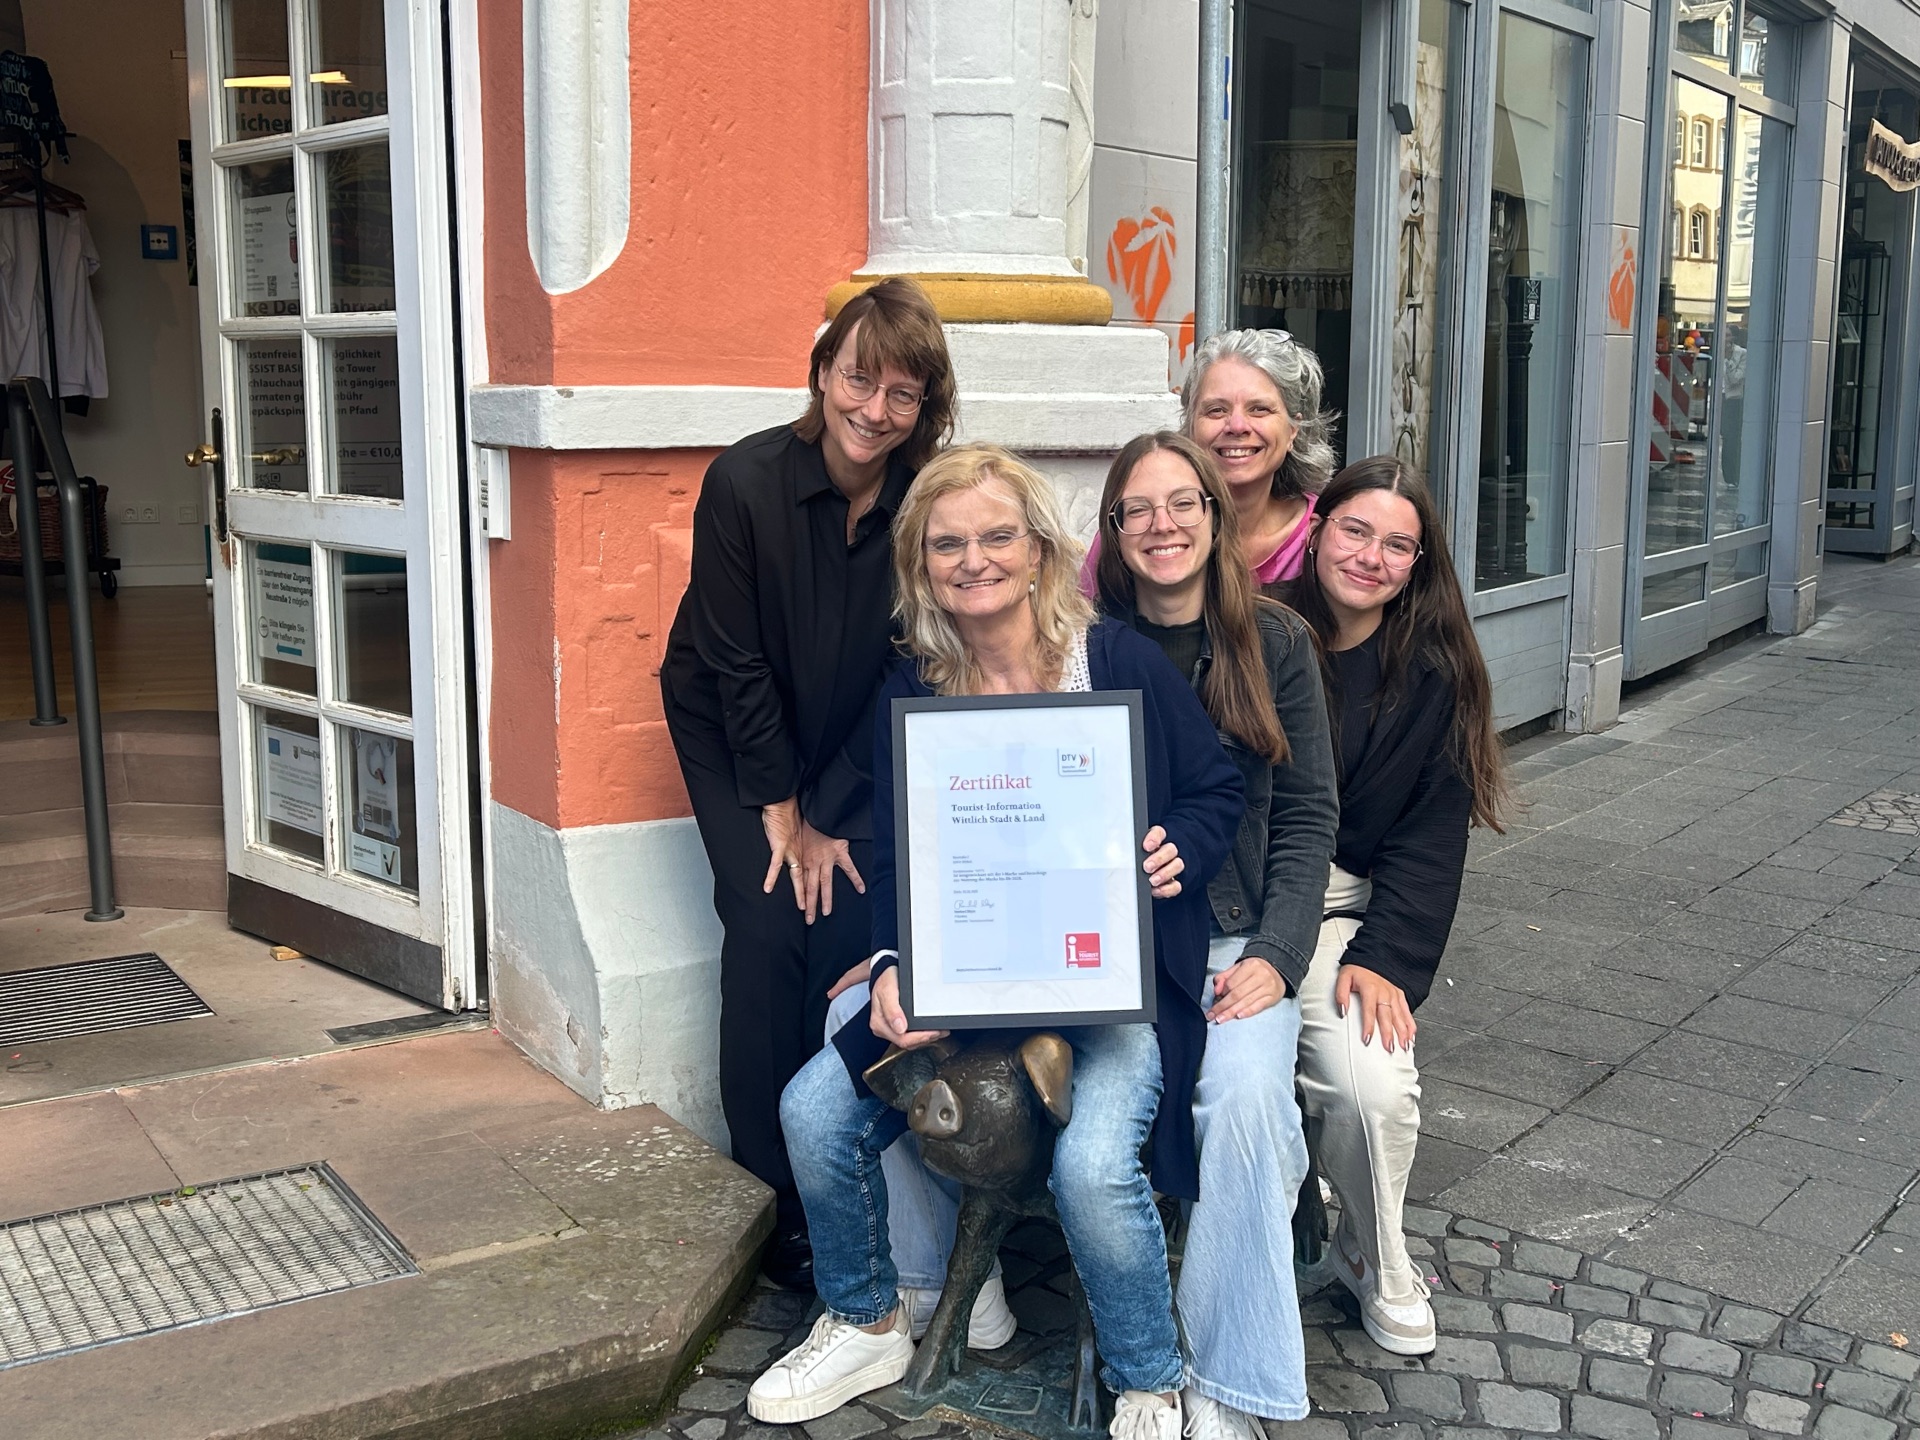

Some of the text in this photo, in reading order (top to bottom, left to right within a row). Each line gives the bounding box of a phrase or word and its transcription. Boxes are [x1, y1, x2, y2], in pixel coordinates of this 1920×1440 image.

[247, 349, 297, 359] ostenfreie
[249, 364, 276, 373] SSIST
[278, 364, 302, 373] BASI
[347, 363, 376, 373] Tower
[248, 378, 303, 388] chlauchaut
[350, 378, 396, 389] gängigen
[249, 393, 291, 402] ormaten
[251, 405, 304, 417] epäckspin
[350, 405, 378, 415] Pfand
[370, 447, 401, 459] €10,0
[293, 572, 311, 584] Zugang
[1061, 753, 1077, 762] DTV
[949, 773, 1033, 791] Zertifikat
[952, 813, 1046, 824] Wittlich Stadt & Land
